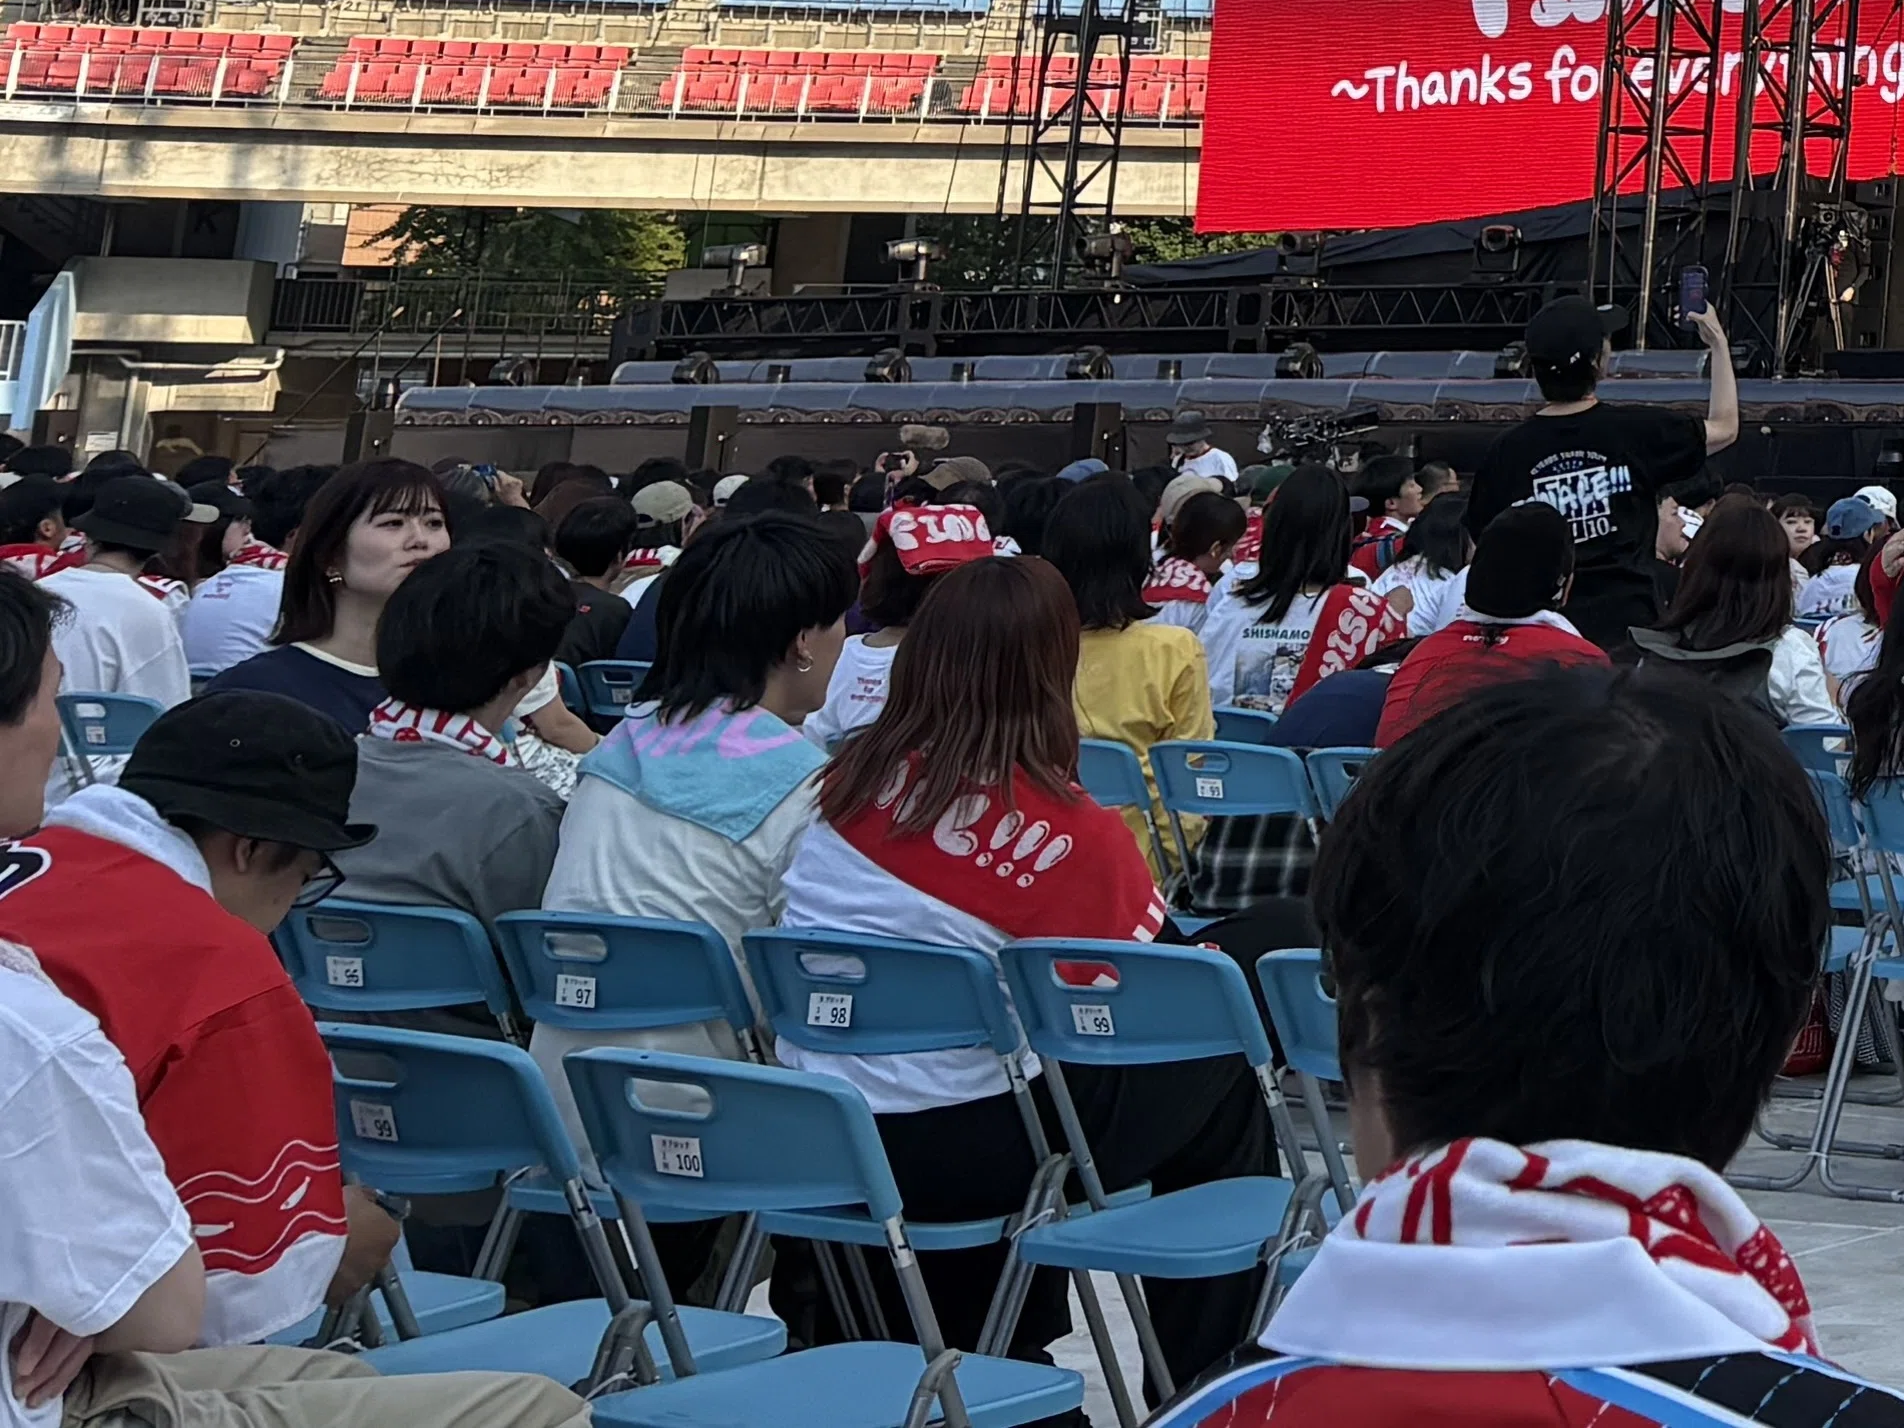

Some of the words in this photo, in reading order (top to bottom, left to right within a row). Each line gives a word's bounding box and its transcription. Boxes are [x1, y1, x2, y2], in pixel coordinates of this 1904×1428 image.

[343, 1, 361, 11] 21
[1544, 44, 1604, 104] fo
[576, 988, 592, 1005] 97
[830, 1007, 847, 1024] 98
[1093, 1017, 1111, 1033] 99
[374, 1119, 393, 1138] 99
[676, 1154, 701, 1172] 100
